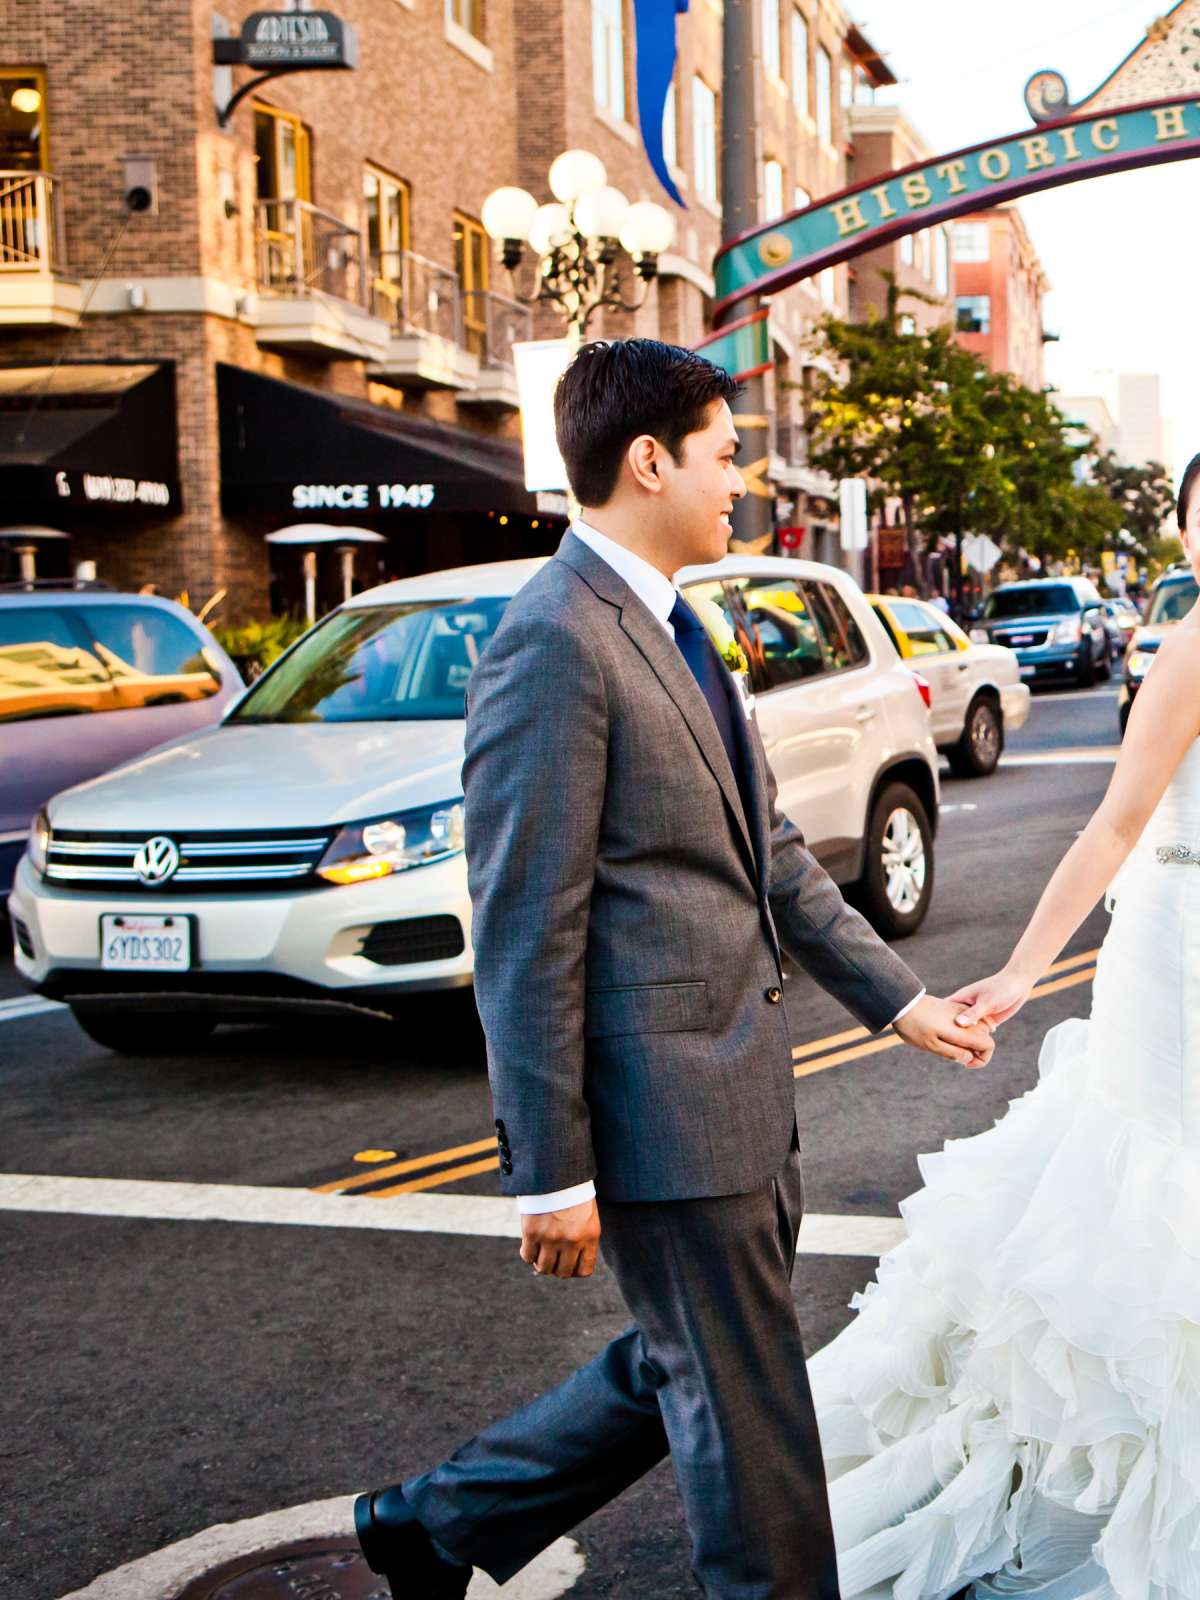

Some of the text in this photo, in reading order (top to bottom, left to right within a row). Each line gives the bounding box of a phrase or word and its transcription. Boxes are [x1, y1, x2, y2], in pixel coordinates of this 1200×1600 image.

[828, 117, 1121, 236] HISTORIC
[292, 484, 435, 508] SINCE 1945
[108, 936, 183, 962] 6YDS302
